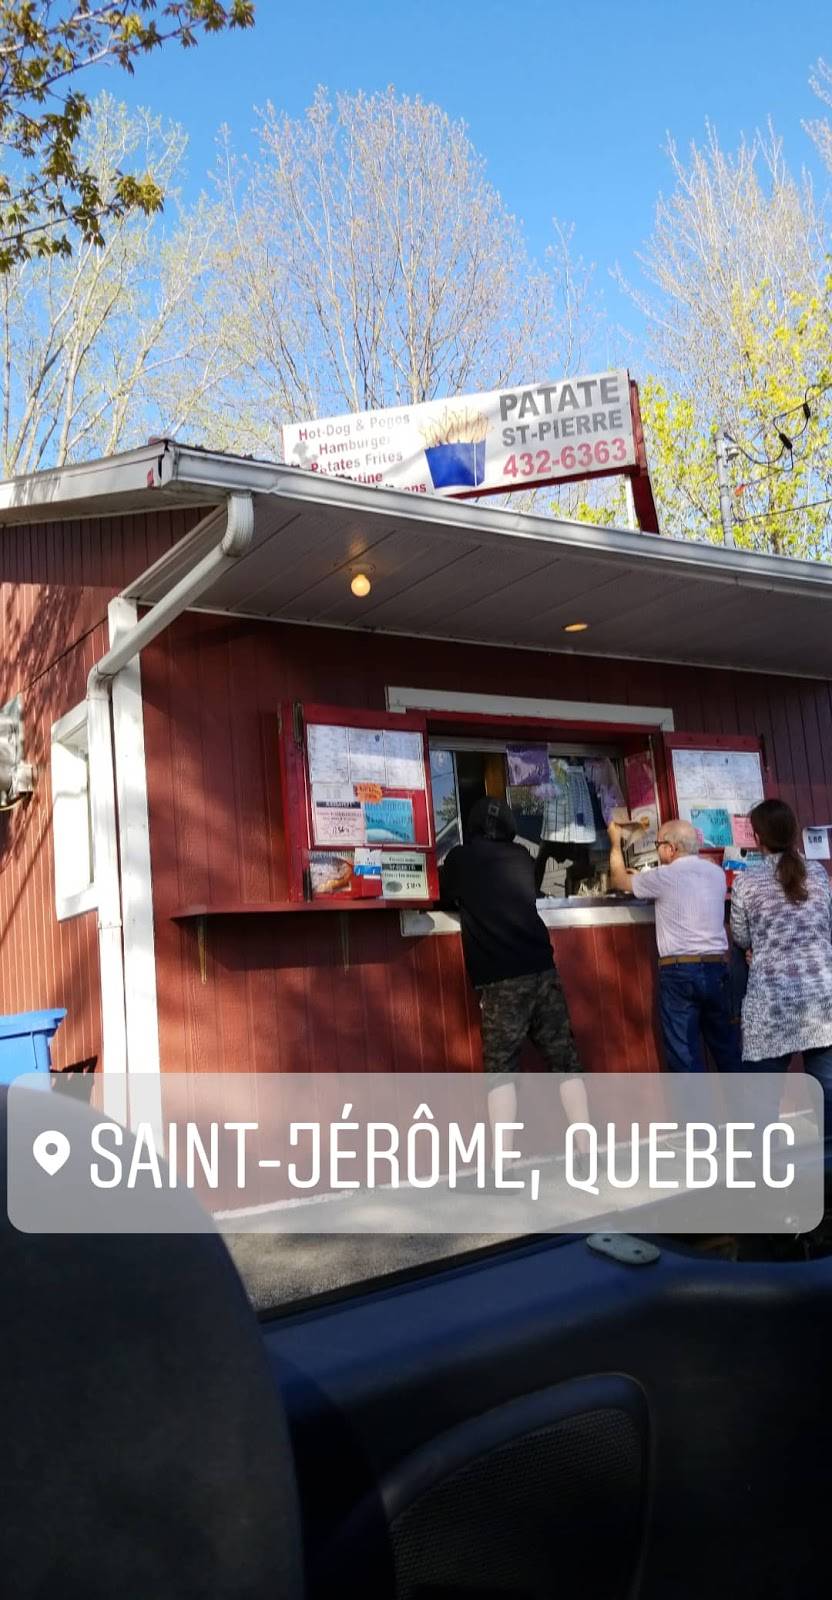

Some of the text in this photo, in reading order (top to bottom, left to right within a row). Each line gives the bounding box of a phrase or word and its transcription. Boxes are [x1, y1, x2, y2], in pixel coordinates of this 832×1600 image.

[499, 376, 620, 421] PATATE
[299, 424, 351, 441] Hot-Dog
[356, 420, 364, 430] &
[502, 409, 623, 447] ST-PIERRE
[365, 451, 403, 467] Frites
[503, 438, 627, 478] 432-6363
